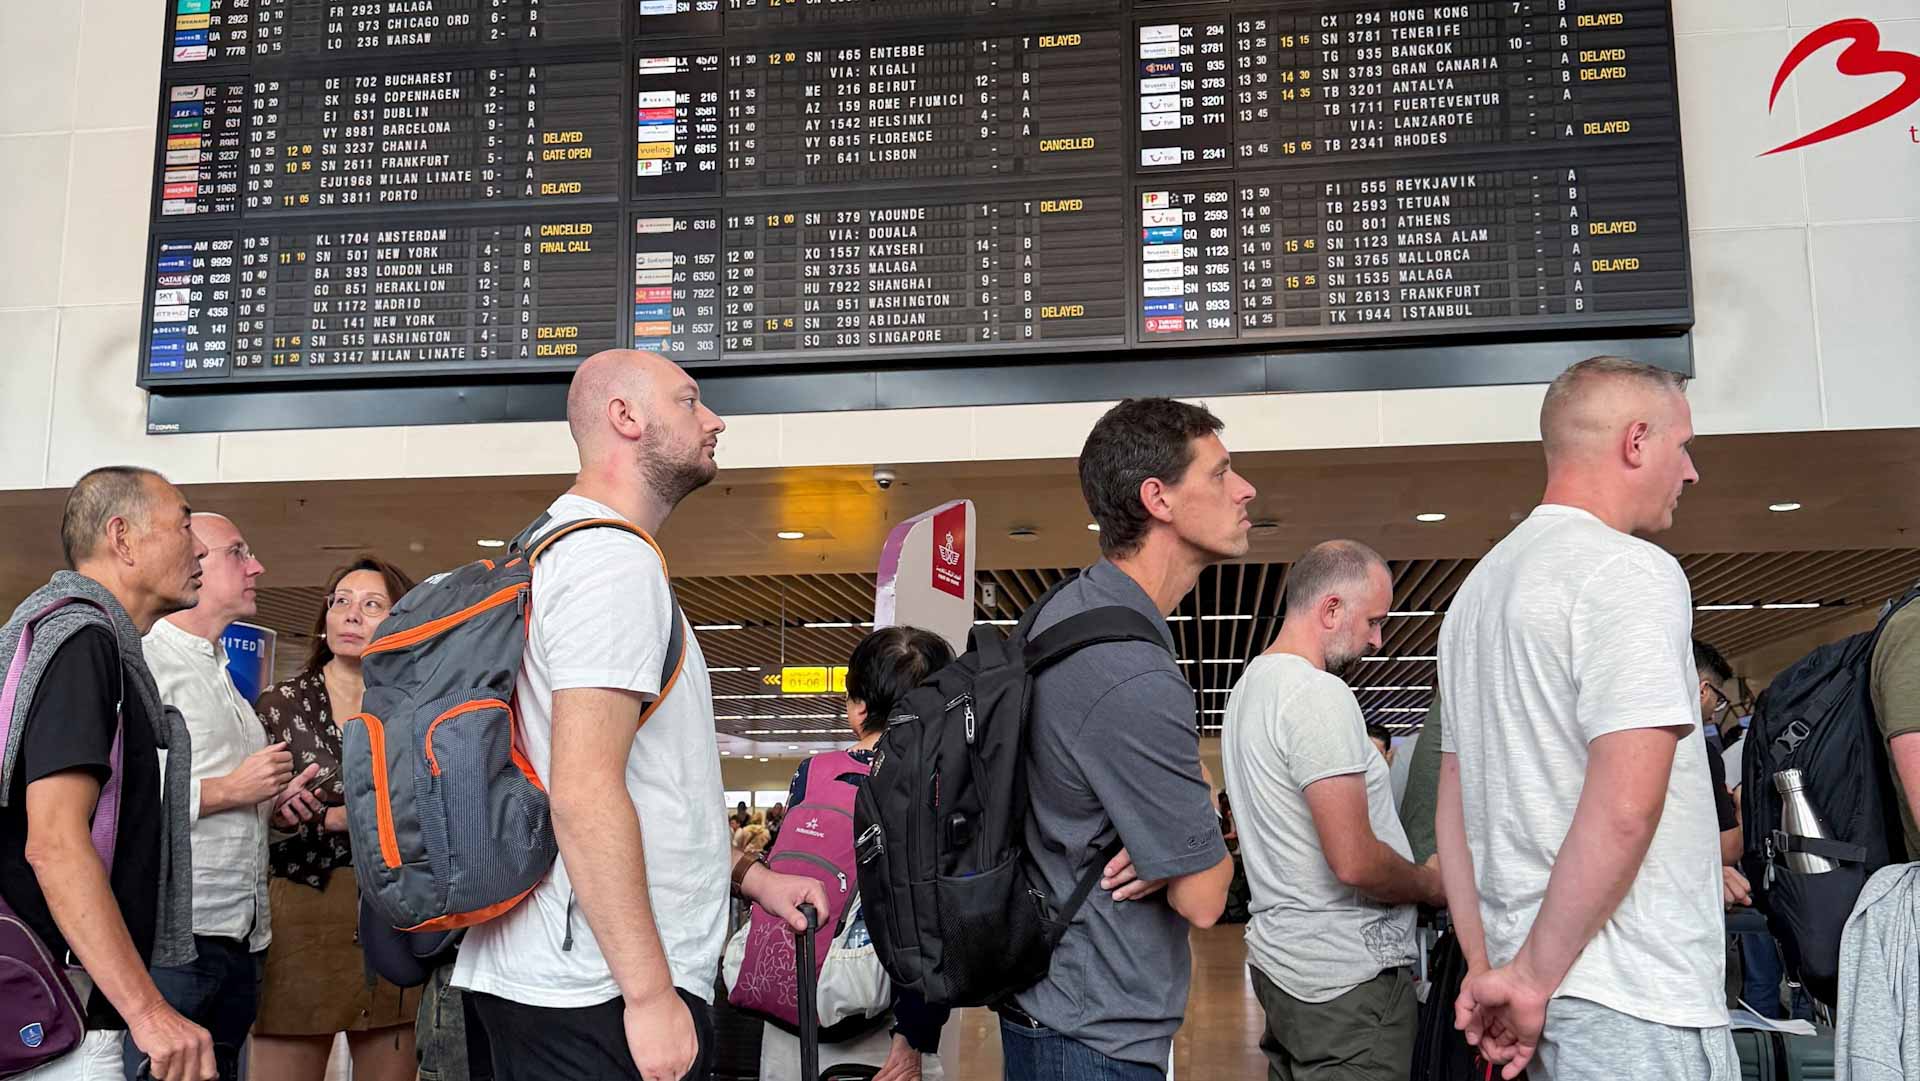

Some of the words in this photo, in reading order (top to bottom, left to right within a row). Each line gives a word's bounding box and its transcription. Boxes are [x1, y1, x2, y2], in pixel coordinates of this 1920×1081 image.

[352, 4, 380, 16] 2923
[388, 1, 432, 13] MALAGA
[1356, 12, 1380, 24] 294
[1390, 9, 1424, 22] HONG
[1434, 6, 1468, 19] KONG
[358, 20, 379, 31] 973
[388, 16, 439, 29] CHICAGO
[447, 14, 469, 26] ORD
[1348, 30, 1380, 43] 3781
[1391, 24, 1460, 40] TENERIFE
[1578, 13, 1623, 27] DELAYED
[357, 36, 378, 47] 236
[387, 33, 431, 45] WARSAW
[838, 49, 861, 60] 465
[870, 45, 924, 59] ENTEBBE
[1039, 34, 1081, 47] DELAYED
[1357, 47, 1382, 60] 935
[1392, 42, 1452, 57] BANGKOK
[830, 67, 859, 78] VIA:
[870, 63, 915, 76] KIGALI
[1155, 63, 1174, 71] THAI
[1180, 62, 1193, 72] TG
[1207, 60, 1225, 71] 935
[1349, 65, 1382, 78] 3783
[1392, 62, 1426, 75] GRAN
[1436, 57, 1498, 72] CANARIA
[1580, 49, 1625, 62] DELAYED
[356, 76, 377, 87] 702
[385, 72, 452, 86] BUCHAREST
[838, 83, 860, 95] 216
[869, 80, 916, 93] BEIRUT
[1349, 83, 1381, 96] 3201
[1393, 78, 1454, 93] ANTALYA
[1580, 67, 1626, 80] DELAYED
[355, 93, 376, 104] 594
[385, 89, 460, 103] COPENHAGEN
[838, 100, 860, 112] 159
[869, 98, 900, 110] ROME
[910, 94, 963, 108] FIUMICI
[1350, 101, 1382, 114] 1711
[1394, 93, 1499, 111] FUERTEVENTUR
[354, 109, 374, 120] 631
[384, 106, 428, 119] DUBLIN
[830, 118, 860, 129] 1542
[869, 113, 931, 127] HELSINKI
[345, 126, 373, 137] 8981
[383, 122, 450, 135] BARCELONA
[1350, 119, 1382, 131] VIA:
[1395, 113, 1473, 128] LANZAROTE
[345, 142, 374, 154] 3237
[382, 139, 427, 152] CHANIA
[543, 132, 583, 144] DELAYED
[829, 135, 860, 147] 6815
[870, 130, 932, 144] FLORENCE
[1351, 137, 1383, 149] 2341
[1394, 132, 1447, 147] RHODES
[1584, 121, 1630, 134] DELAYED
[640, 145, 671, 155] vueling
[675, 145, 687, 154] VY
[694, 143, 717, 154] 6815
[838, 152, 859, 163] 641
[870, 149, 916, 161] LISBON
[1040, 137, 1094, 151] CANCELLED
[344, 159, 372, 170] 2611
[382, 155, 449, 168] FRANKFURT
[543, 149, 566, 160] GATE
[568, 148, 592, 159] OPEN
[640, 161, 652, 169] TP
[675, 162, 687, 171] TP
[699, 161, 715, 171] 641
[380, 173, 418, 184] MILAN
[427, 171, 471, 183] LINATE
[1361, 181, 1386, 193] 555
[1396, 175, 1475, 191] REYKJAVIK
[342, 192, 370, 203] 3811
[380, 190, 417, 201] PORTO
[541, 182, 581, 194] DELAYED
[1144, 194, 1158, 203] TP
[1183, 194, 1195, 204] TP
[1204, 192, 1228, 203] 5620
[837, 212, 860, 223] 379
[870, 208, 925, 221] YAOUNDE
[1041, 199, 1083, 212] DELAYED
[1353, 199, 1387, 212] 2593
[1397, 195, 1450, 209] TETUAN
[1362, 217, 1386, 230] 801
[1398, 213, 1450, 227] ATHENS
[340, 233, 369, 244] 1704
[377, 229, 446, 242] AMSTERDAM
[541, 224, 592, 236] CANCELLED
[829, 229, 859, 240] VIA:
[869, 226, 917, 239] DOUALA
[1354, 235, 1388, 248] 1123
[1398, 232, 1442, 245] MARSA
[1452, 229, 1487, 242] ALAM
[1590, 221, 1636, 234] DELAYED
[347, 250, 367, 261] 501
[377, 248, 400, 259] NEW
[408, 247, 438, 258] YORK
[540, 242, 566, 253] FINAL
[568, 241, 591, 252] CALL
[830, 246, 860, 258] 1557
[869, 243, 923, 256] KAYSERI
[1355, 253, 1388, 266] 3765
[1399, 249, 1470, 263] MALLORCA
[346, 266, 367, 278] 393
[377, 264, 422, 276] LONDON
[431, 263, 453, 274] LHR
[829, 264, 860, 275] 3735
[869, 261, 917, 273] MALAGA
[1356, 272, 1389, 284] 1535
[1399, 268, 1452, 282] MALAGA
[1592, 258, 1639, 271] DELAYED
[192, 275, 204, 284] QR
[210, 273, 231, 284] 6228
[345, 283, 366, 294] 851
[376, 280, 445, 293] HERAKLION
[829, 281, 860, 292] 7922
[869, 278, 931, 291] SHANGHAI
[837, 299, 858, 310] 951
[869, 294, 949, 308] WASHINGTON
[1356, 290, 1390, 302] 2613
[1401, 285, 1480, 300] FRANKFURT
[338, 300, 366, 311] 1172
[375, 298, 420, 310] MADRID
[1357, 308, 1390, 321] 1944
[1403, 304, 1472, 318] ISTANBUL
[344, 317, 364, 328] 141
[374, 316, 396, 327] NEW
[405, 315, 435, 326] YORK
[837, 316, 860, 327] 299
[869, 313, 925, 326] ABIDJAN
[1041, 305, 1084, 318] DELAYED
[342, 334, 364, 345] 515
[373, 331, 450, 344] WASHINGTON
[538, 326, 578, 338] DELAYED
[837, 333, 860, 344] 303
[869, 330, 941, 343] SINGAPORE
[333, 351, 363, 363] 3147
[372, 350, 410, 361] MILAN
[419, 347, 465, 360] LINATE
[537, 344, 577, 355] DELAYED
